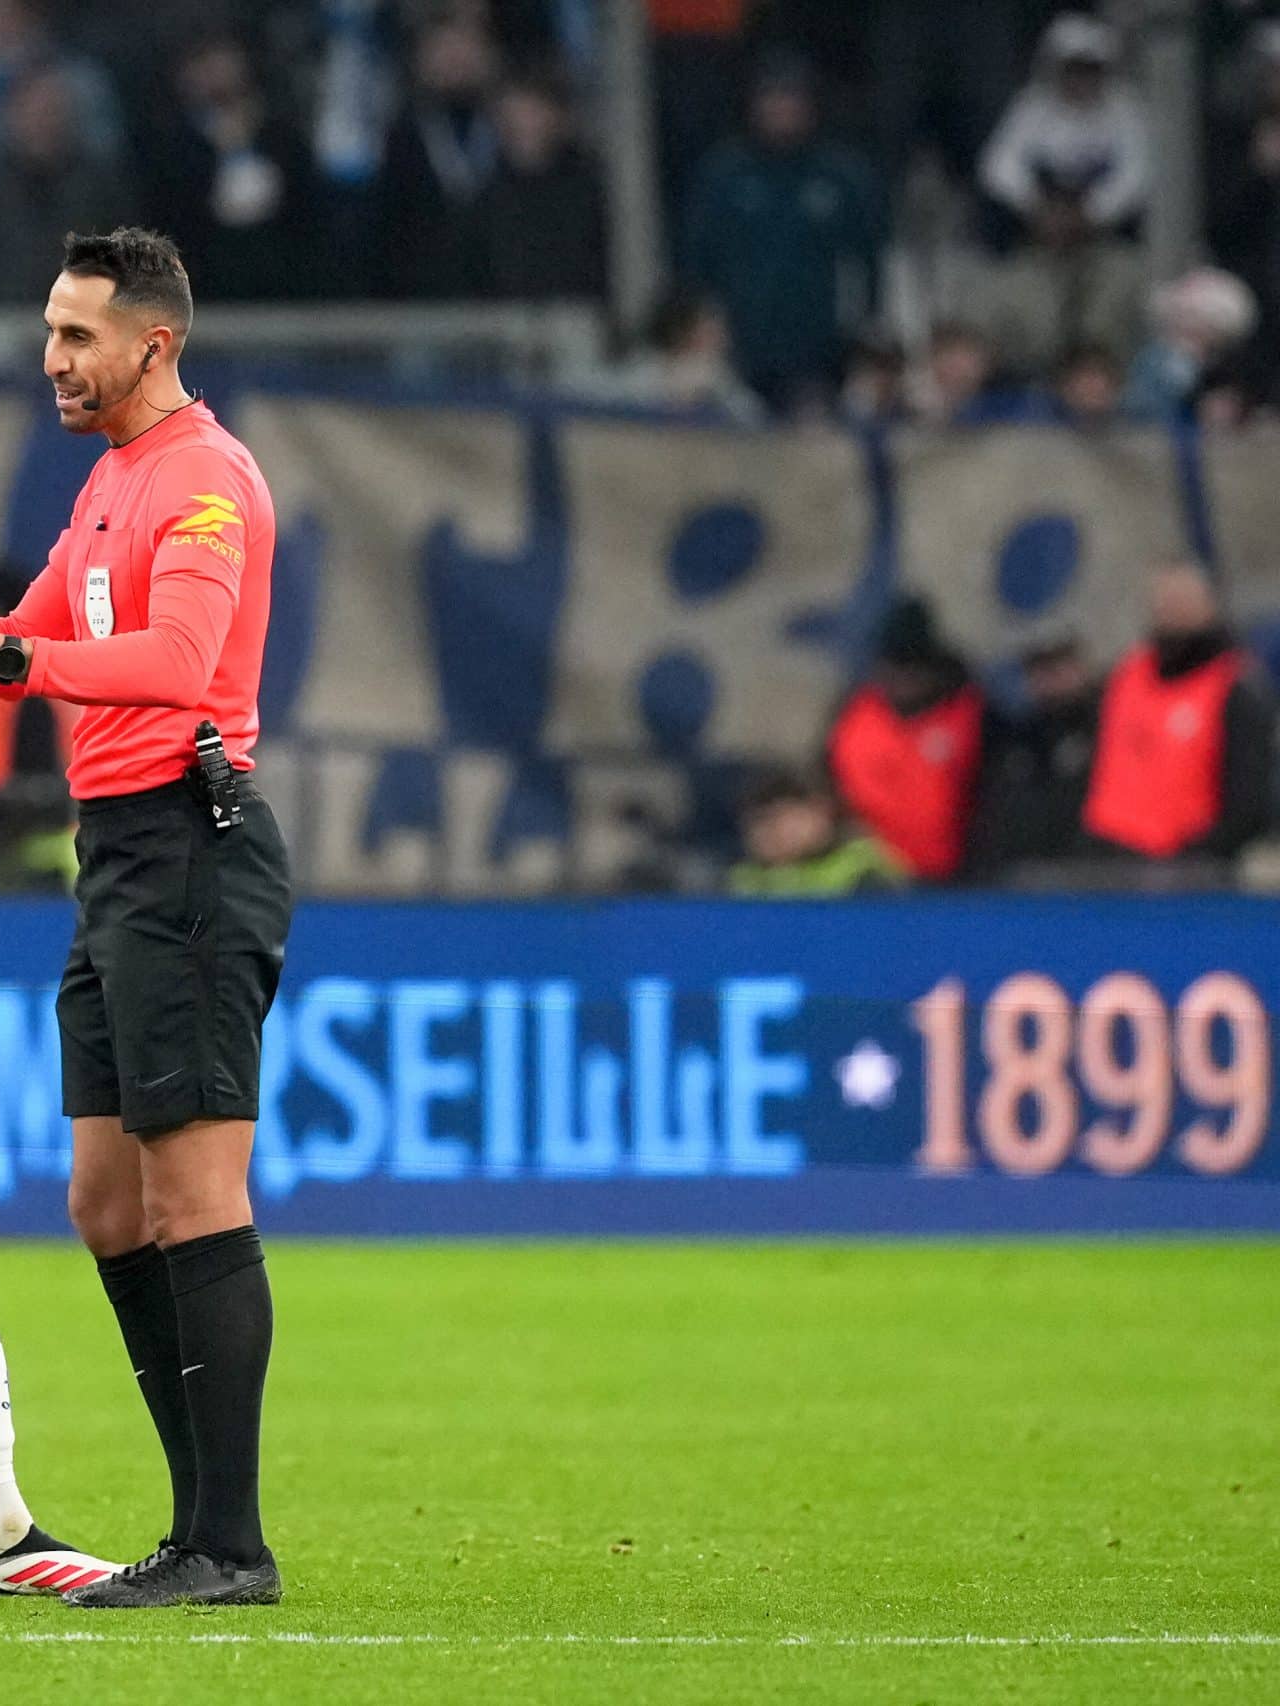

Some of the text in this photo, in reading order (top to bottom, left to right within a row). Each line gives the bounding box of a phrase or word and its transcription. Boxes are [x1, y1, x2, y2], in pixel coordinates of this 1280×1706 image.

[171, 535, 242, 565] LA POSTE
[910, 968, 1270, 1180] 1899
